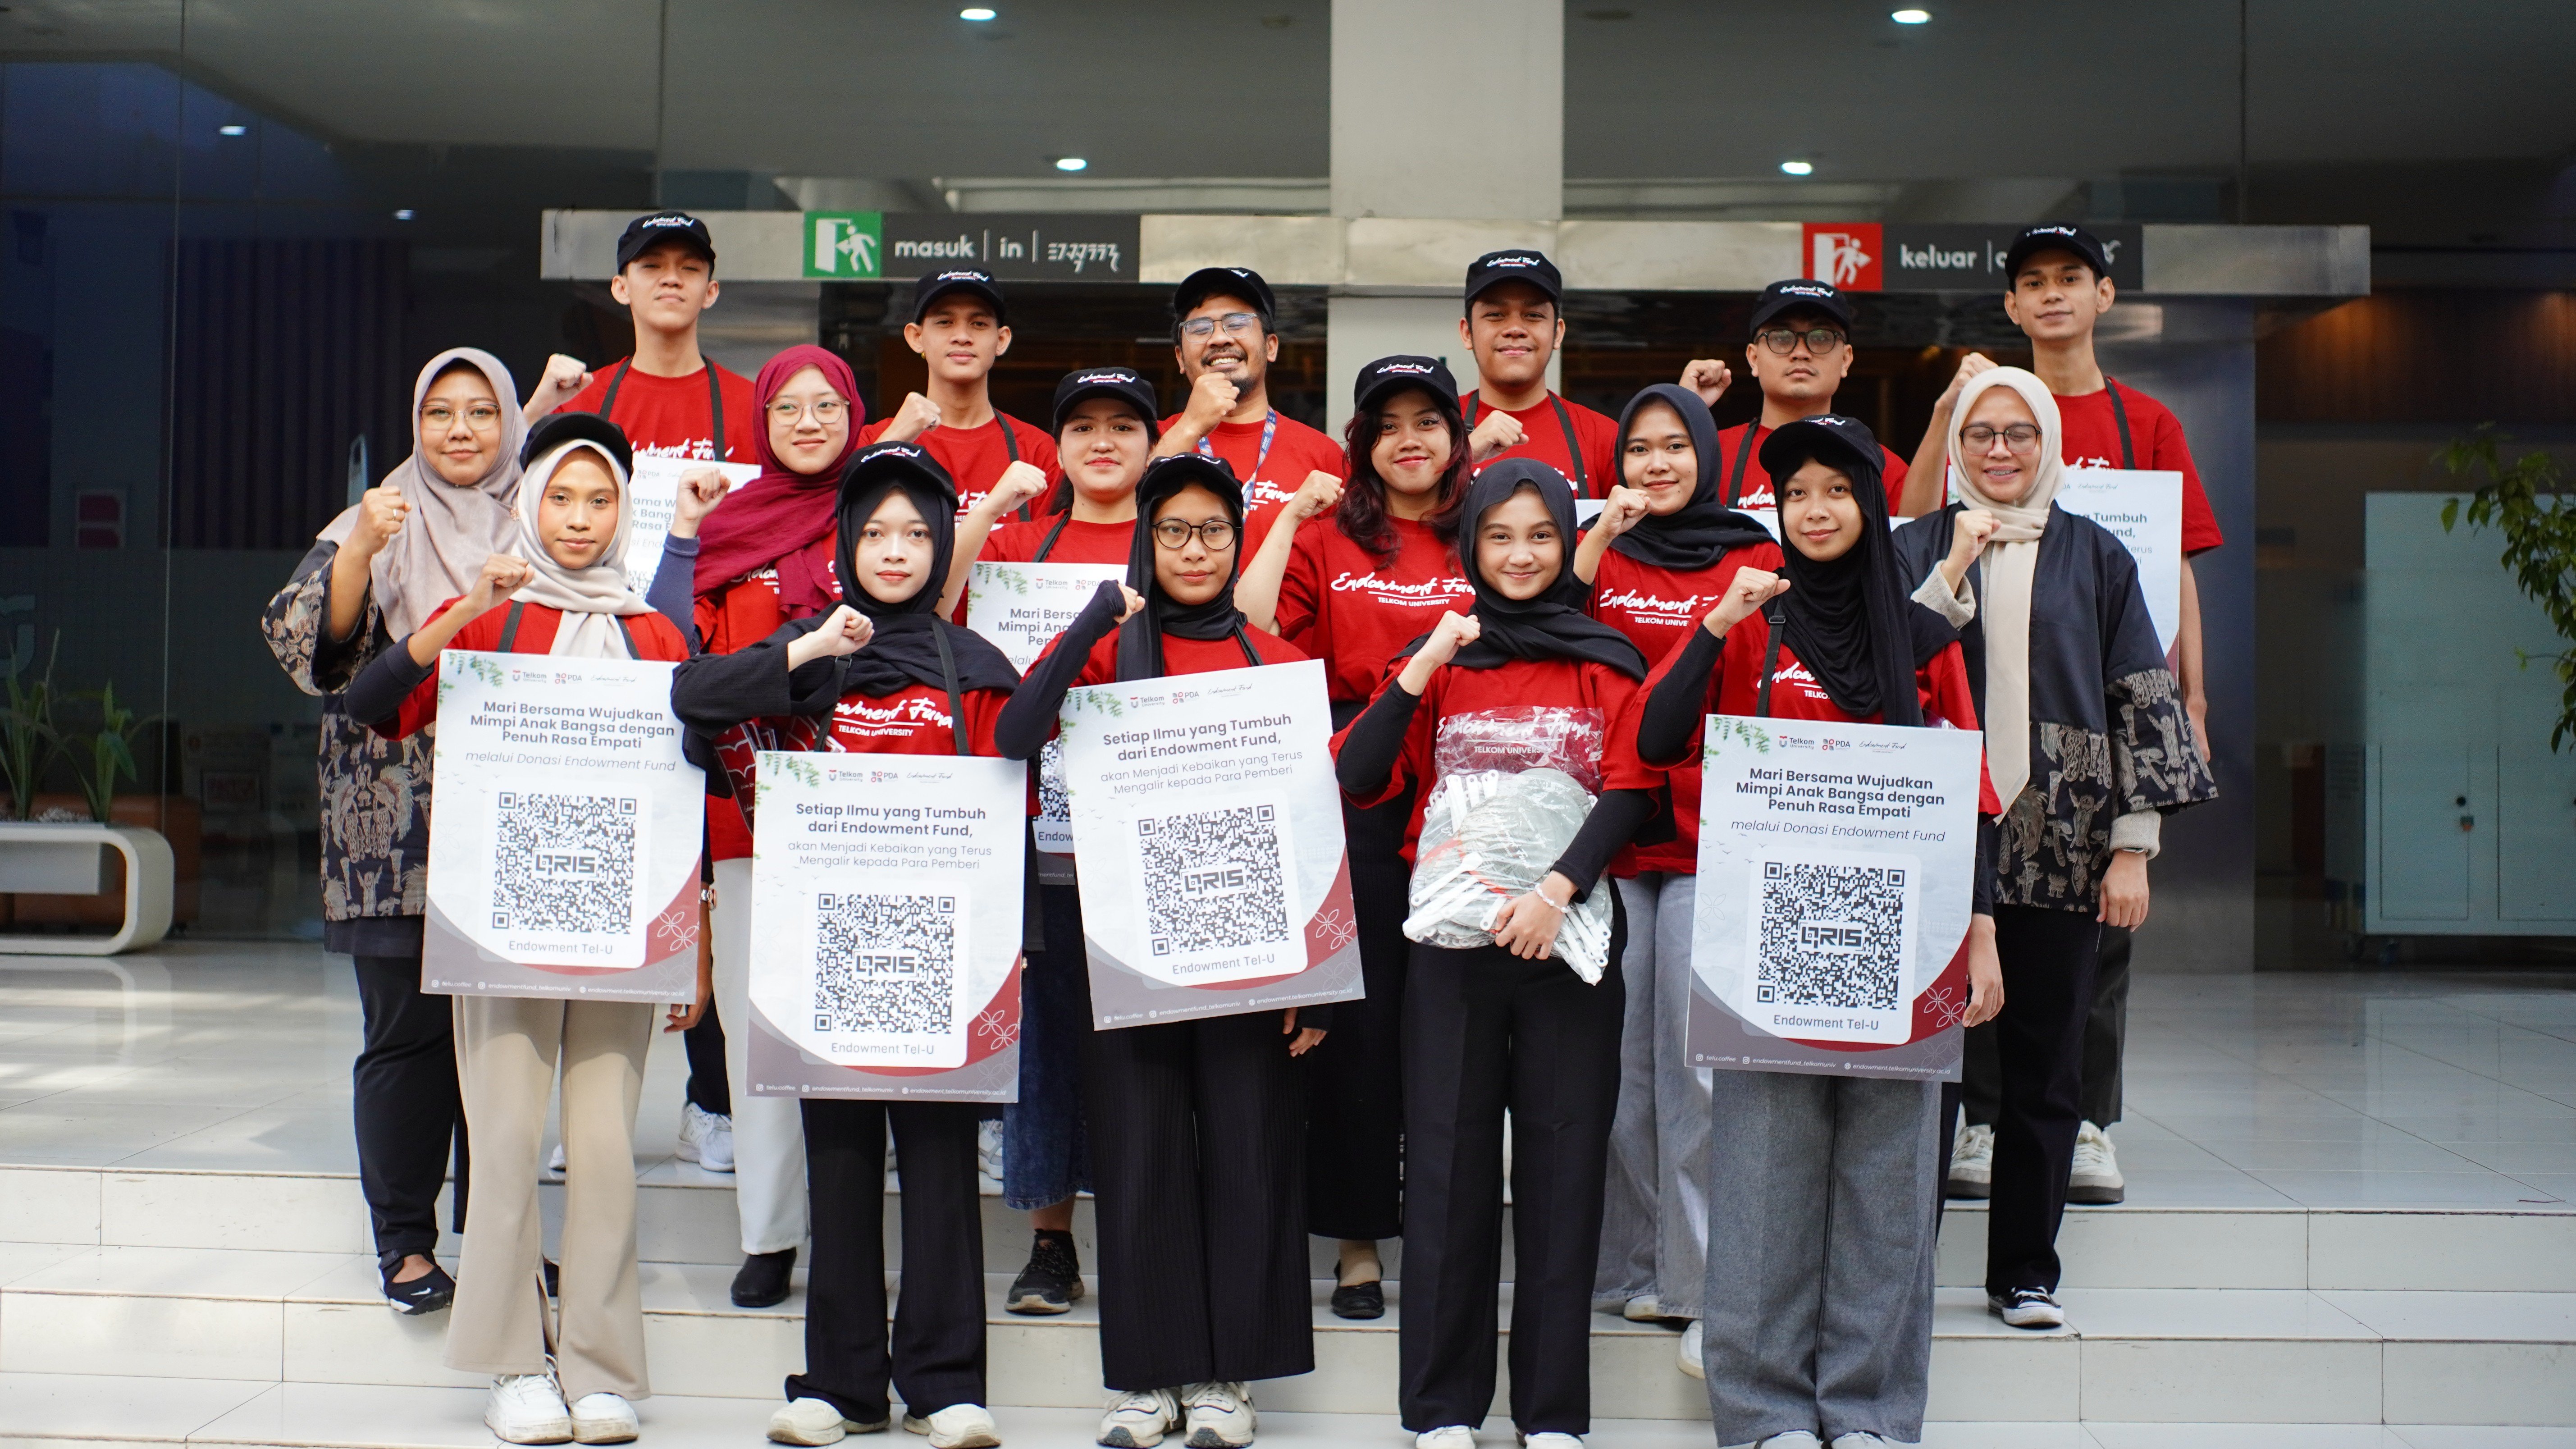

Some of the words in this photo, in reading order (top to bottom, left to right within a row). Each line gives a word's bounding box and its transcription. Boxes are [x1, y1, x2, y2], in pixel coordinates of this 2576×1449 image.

[895, 235, 974, 257] masuk
[1000, 238, 1022, 257] in
[1901, 244, 1976, 267] keluar
[632, 521, 662, 530] Rasa
[2094, 513, 2147, 523] Tumbuh
[1330, 572, 1437, 596] Endowment
[1378, 597, 1407, 606] TELKOM
[1408, 599, 1450, 607] UNIVERSITY
[1010, 608, 1040, 618] Mari
[1635, 617, 1663, 625] TELKOM
[999, 622, 1040, 634] Mimpi
[484, 702, 516, 713] Mari
[520, 704, 584, 716] Bersama
[589, 708, 662, 722] Wujudkan
[471, 715, 515, 731] Mimpi
[520, 718, 556, 729] Anak
[562, 720, 615, 735] Bangsa
[620, 723, 675, 738] dengan
[838, 725, 870, 736] TELKOM
[871, 727, 913, 736] UNIVERSITY
[1104, 731, 1149, 745] Setiap
[1154, 728, 1185, 739] Ilmu
[1189, 724, 1226, 739] yang
[1230, 714, 1291, 730] Tumbuh
[503, 731, 547, 743] Penuh
[552, 734, 586, 745] Rasa
[591, 736, 641, 750] Empati
[1118, 747, 1146, 760] dari
[1151, 738, 1237, 757] Endowment
[1241, 732, 1280, 746] Fund,
[1474, 746, 1505, 754] TELKOM
[466, 752, 513, 762] melalui
[517, 754, 561, 764] Donasi
[565, 756, 640, 769] Endowment
[645, 761, 676, 771] Fund
[1101, 772, 1129, 782] akan
[1133, 764, 1178, 778] Menjadi
[1183, 758, 1235, 772] Kebaikan
[1239, 756, 1268, 768] yang
[1271, 752, 1302, 761] Terus
[1114, 780, 1164, 794] Mengalir
[1168, 775, 1211, 789] kepada
[1215, 771, 1241, 782] Para
[1245, 765, 1292, 778] Pemberi
[1750, 768, 1782, 780] Mari
[1787, 771, 1852, 784] Bersama
[1857, 775, 1932, 790] Wujudkan
[1737, 782, 1782, 799] Mimpi
[1786, 786, 1824, 797] Anak
[1828, 788, 1883, 804] Bangsa
[1888, 791, 1944, 807] dengan
[797, 803, 842, 818] Setiap
[847, 805, 878, 816] Ilmu
[883, 809, 920, 821] yang
[925, 808, 985, 819] Tumbuh
[1769, 799, 1814, 812] Penuh
[1819, 802, 1854, 814] Rasa
[1859, 804, 1910, 820] Empati
[808, 821, 837, 832] dari
[842, 823, 928, 834] Endowment
[933, 825, 972, 837] Fund,
[1038, 832, 1073, 841] Endow
[1731, 821, 1780, 831] melalui
[1784, 823, 1828, 834] Donasi
[1832, 826, 1909, 839] Endowment
[1914, 831, 1945, 841] Fund
[788, 841, 817, 850] akan
[821, 842, 866, 854] Menjadi
[871, 844, 923, 853] Kebaikan
[928, 847, 956, 857] yang
[961, 846, 991, 855] Terus
[536, 854, 596, 875] QRIS
[800, 856, 850, 868] Mengalir
[854, 857, 897, 868] kepada
[902, 859, 927, 868] Para
[932, 859, 979, 868] Pemberi
[1185, 869, 1243, 895] QRIS
[1802, 927, 1862, 948] QRIS
[509, 941, 577, 952] Endowment
[582, 944, 612, 954] Tel-U
[857, 955, 914, 976] QRIS
[1173, 959, 1240, 974] Endowment
[1244, 954, 1274, 965] Tel-U
[1114, 1012, 1143, 1021] telu.coffee
[1774, 1015, 1843, 1028] Endowment
[1847, 1019, 1878, 1030] Tel-U
[832, 1043, 899, 1053] Endowment
[904, 1045, 934, 1054] Tel-U
[1753, 1058, 1836, 1068] endowmentfund_telkomuniv
